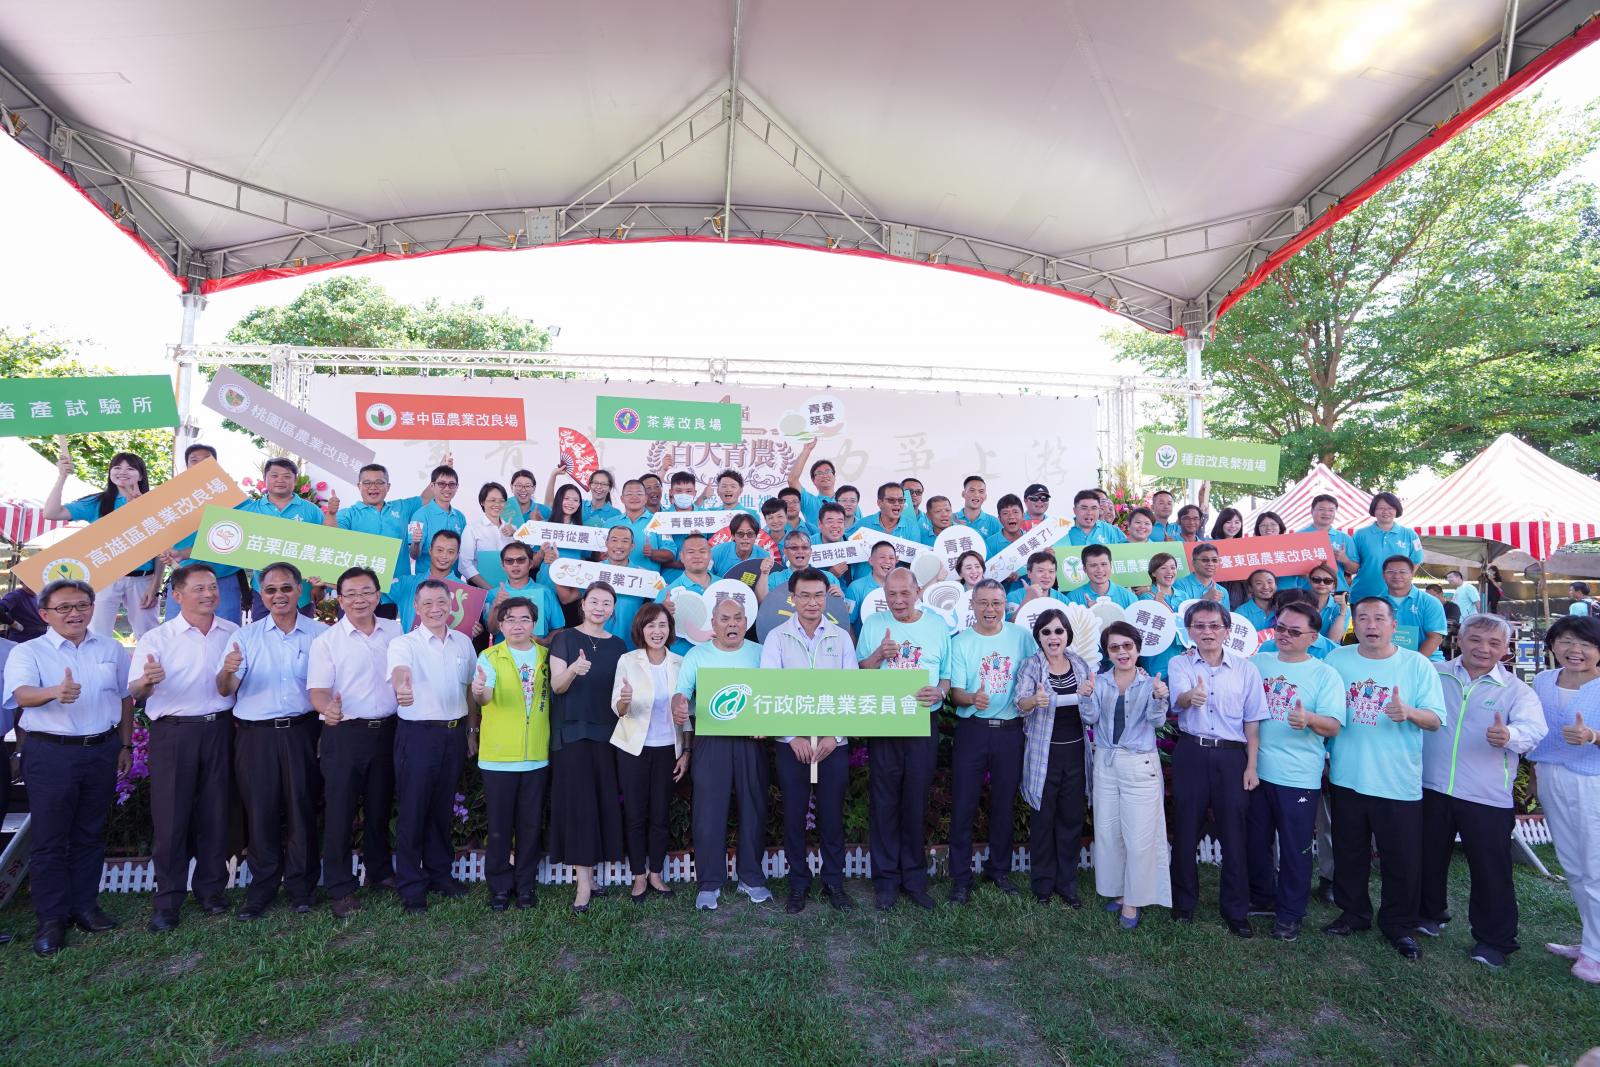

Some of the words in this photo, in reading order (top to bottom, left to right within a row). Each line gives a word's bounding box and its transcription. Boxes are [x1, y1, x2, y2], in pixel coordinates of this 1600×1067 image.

[808, 402, 834, 414] 青春
[401, 411, 519, 428] 臺中區農業改良場
[647, 415, 722, 431] 茶業改良場
[809, 413, 836, 426] 築夢
[251, 404, 365, 473] 桃園區農業改良場
[1182, 453, 1267, 473] 種苗改良繁殖場
[86, 477, 229, 569] 高雄區農業改良場
[671, 516, 716, 529] 青春築夢
[540, 528, 590, 544] 吉時從農
[944, 536, 973, 554] 青春
[1017, 528, 1052, 557] 畢業了!
[246, 534, 387, 574] 苗栗區農業改良場
[812, 546, 859, 562] 吉時從農
[1219, 547, 1328, 569] 臺東區農業改良場
[598, 570, 643, 589] 畢業了!
[1136, 609, 1167, 631] 青春
[753, 694, 918, 716] 行政院農業委員會
